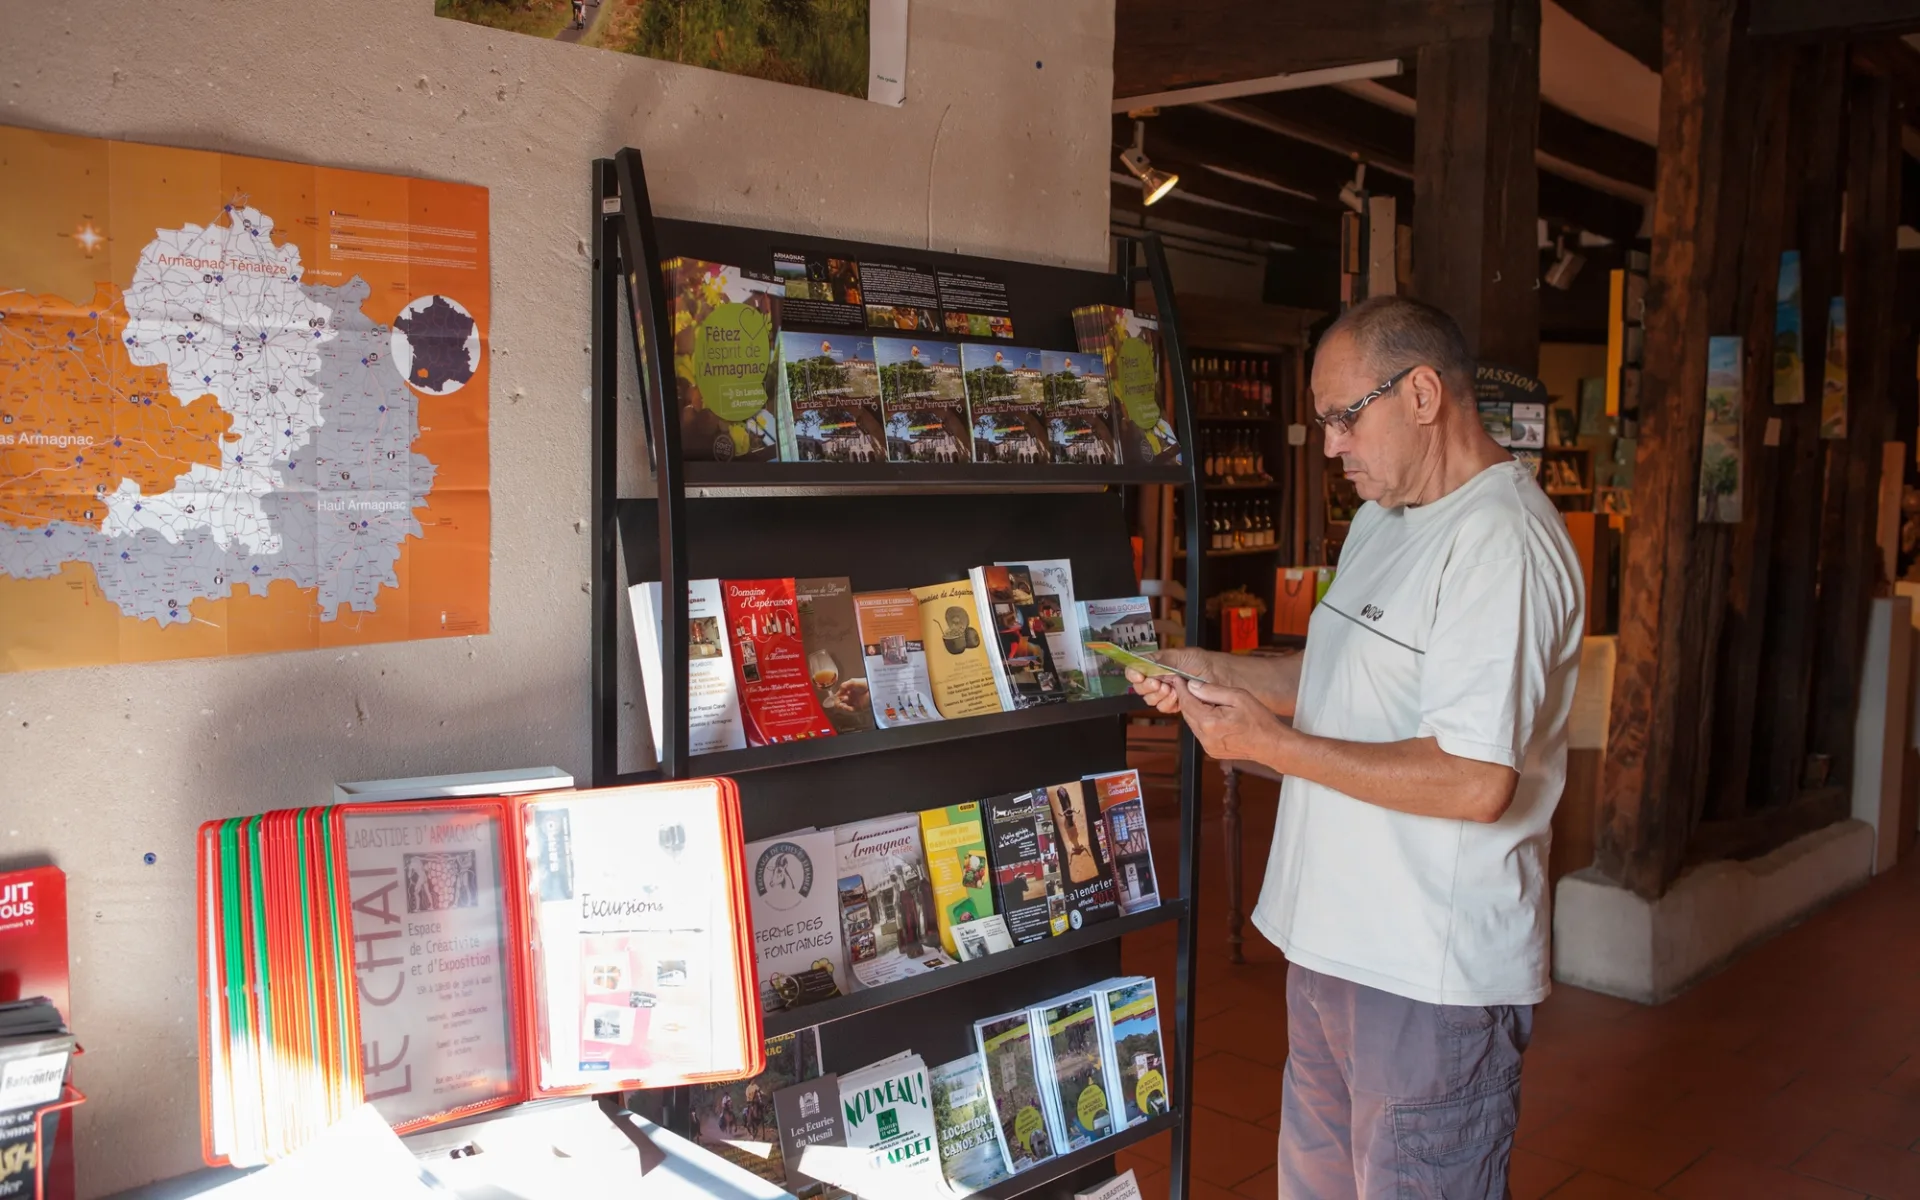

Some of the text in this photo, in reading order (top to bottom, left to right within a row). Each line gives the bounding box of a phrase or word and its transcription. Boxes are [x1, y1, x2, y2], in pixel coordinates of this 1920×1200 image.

[158, 253, 288, 275] Armagnac-Ténarèze
[774, 252, 806, 261] ARMAGNAC
[705, 326, 741, 342] Fêtez
[746, 342, 760, 358] de
[1476, 366, 1538, 392] PASSION
[795, 397, 823, 410] Landes
[887, 400, 912, 412] Landes
[18, 432, 94, 448] Armagnac
[318, 500, 406, 512] Haut Armagnac
[730, 586, 765, 596] Domaine
[740, 596, 793, 610] d'Espérance
[960, 802, 975, 810] GUIDE
[348, 827, 410, 849] LABASTIDE
[845, 836, 911, 860] Armagnac
[1065, 878, 1113, 902] calendrier
[1094, 890, 1116, 904] 2013
[582, 893, 664, 918] Excursions
[408, 922, 441, 937] Espace
[756, 916, 824, 944] FERME DES
[410, 937, 480, 956] de Créativité
[411, 954, 491, 976] et d'Exposition
[790, 1116, 835, 1138] Les Ecuries
[942, 1115, 987, 1140] LOCATION
[796, 1128, 833, 1148] du Mesnil
[943, 1137, 975, 1158] CANOE
